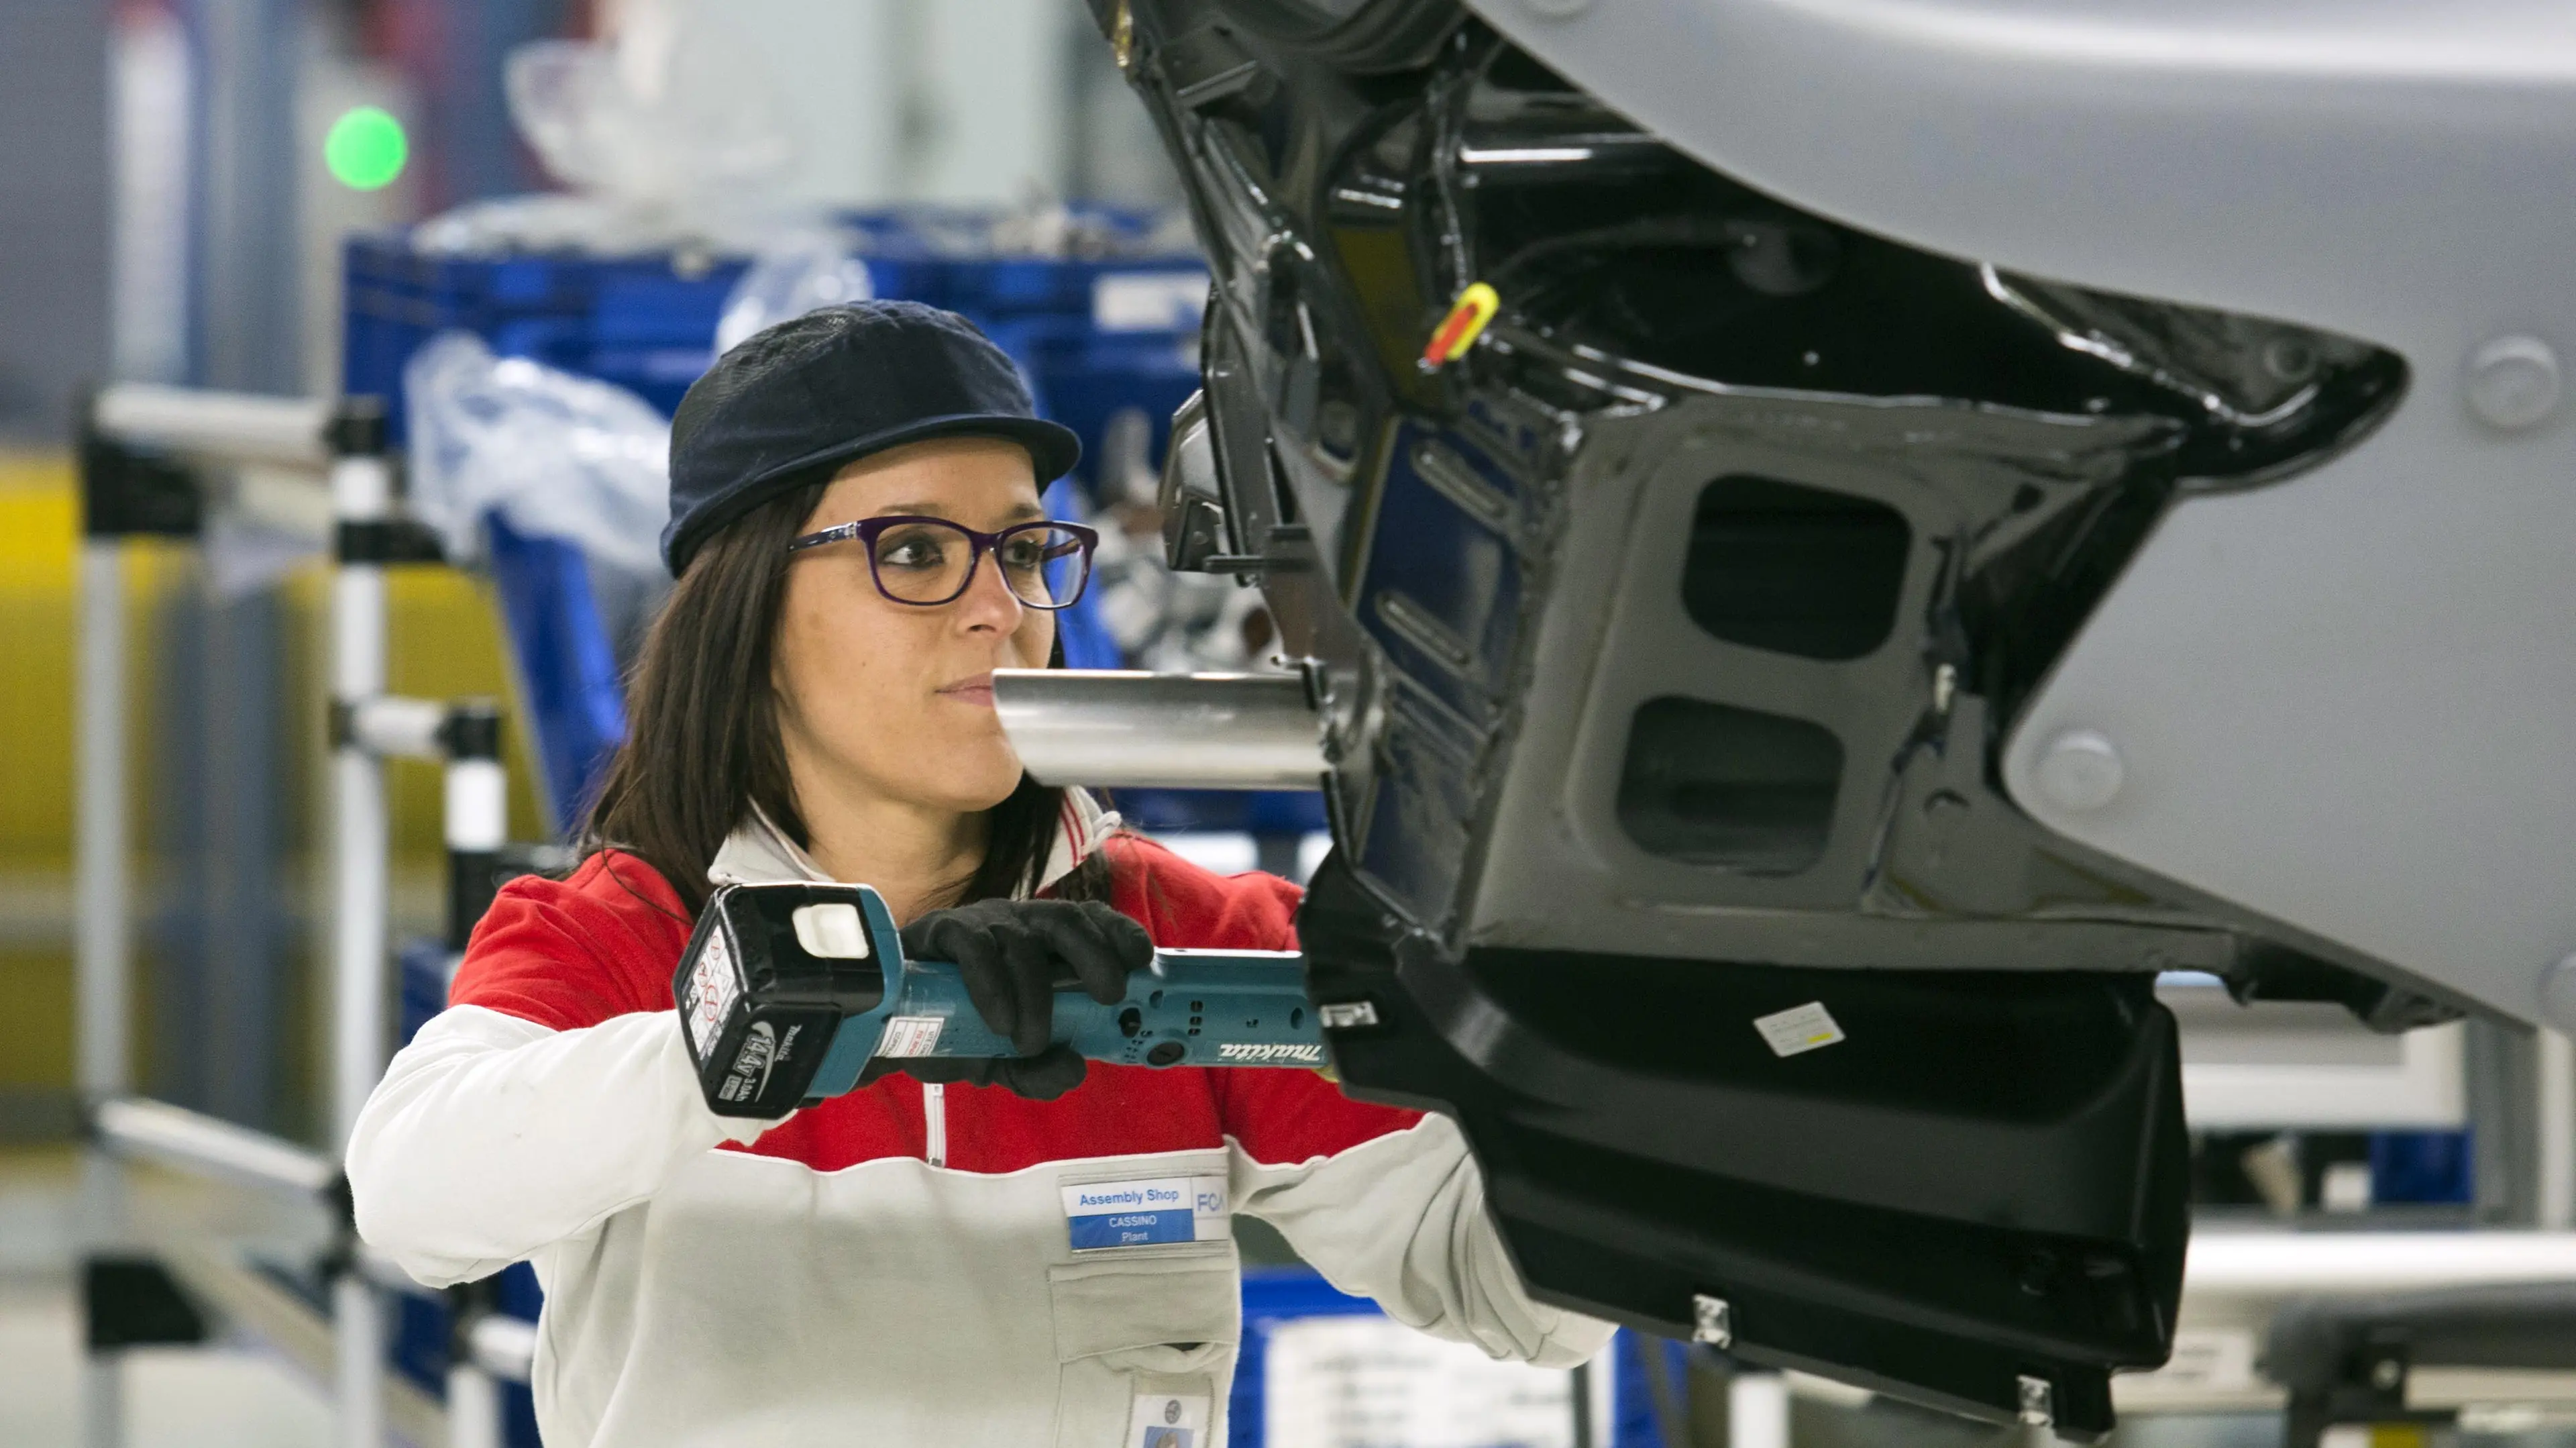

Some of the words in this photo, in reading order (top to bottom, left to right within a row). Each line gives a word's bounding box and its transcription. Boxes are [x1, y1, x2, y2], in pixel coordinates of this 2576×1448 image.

[1080, 1191, 1143, 1206] Assembly
[1146, 1189, 1179, 1202] Shop
[1109, 1215, 1157, 1227] CASSINO
[1122, 1232, 1148, 1241] Plant
